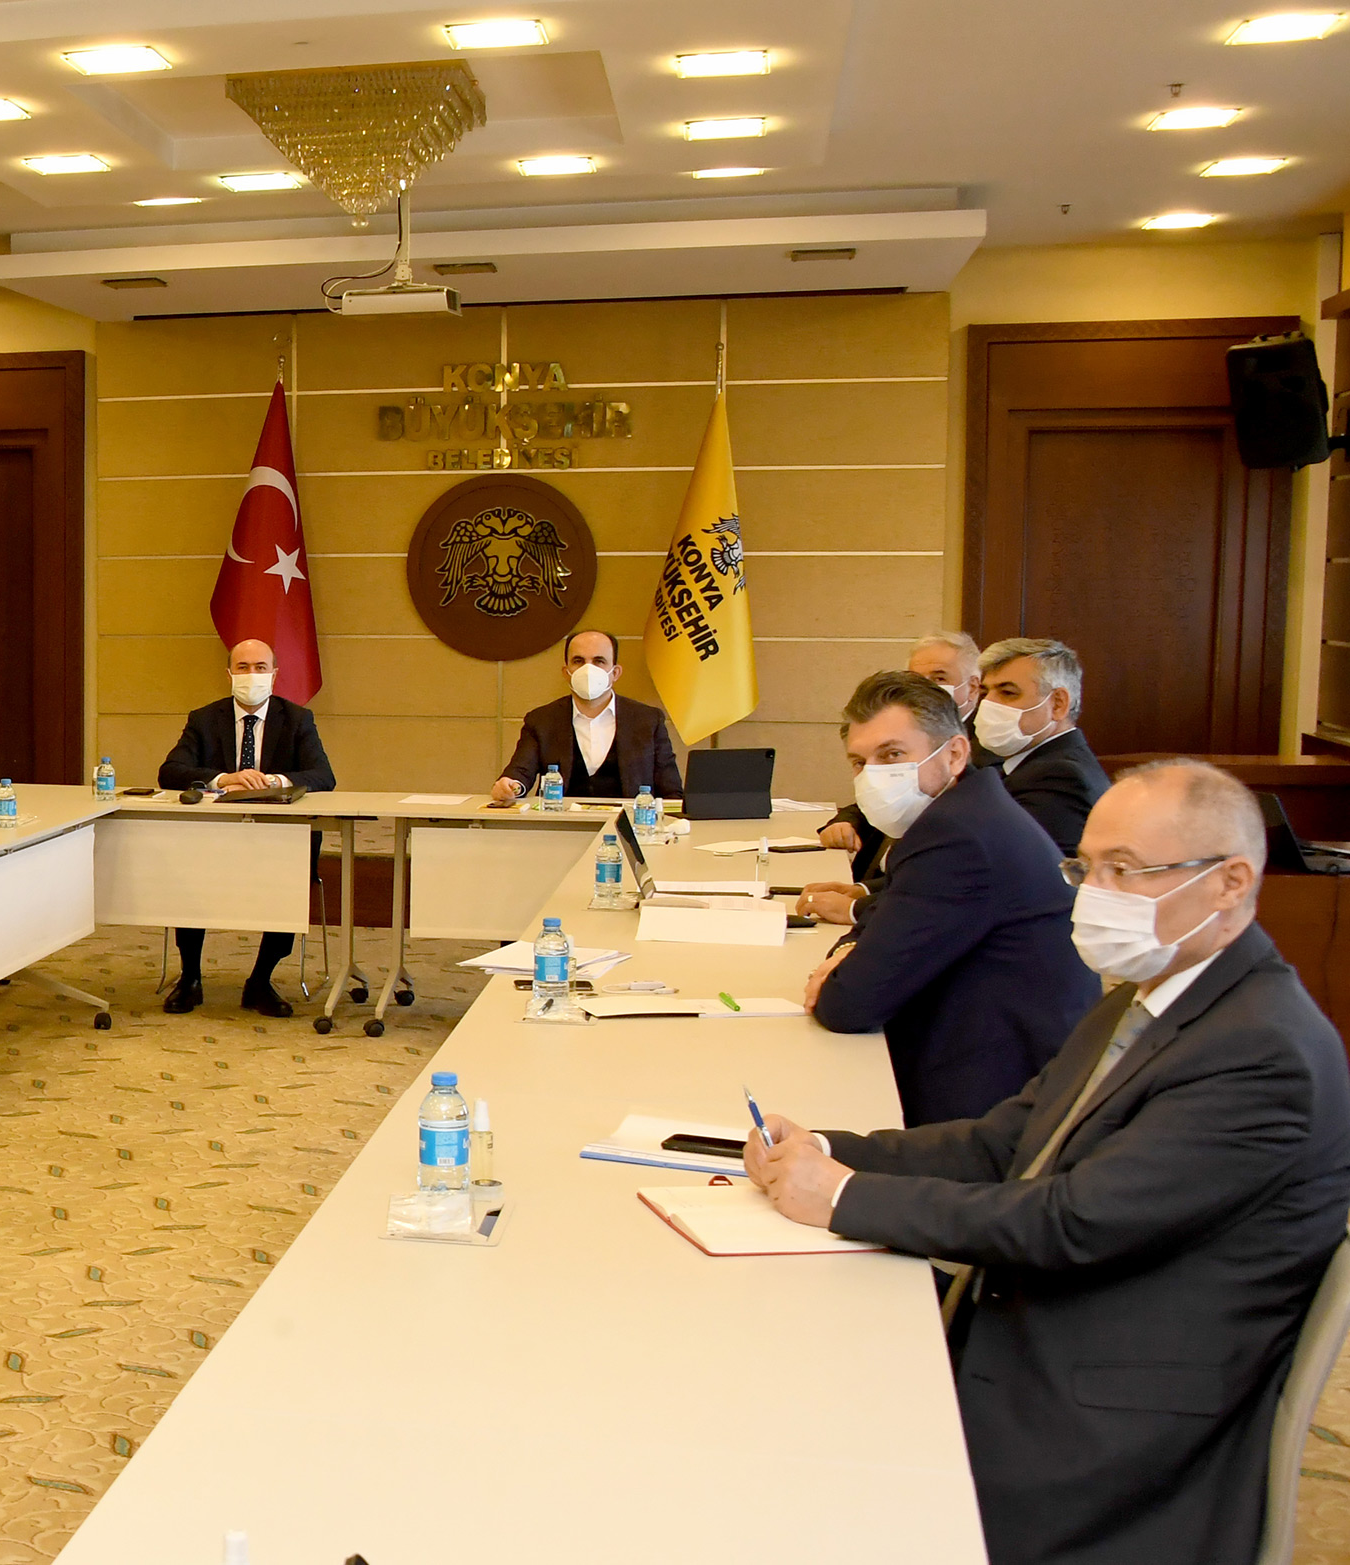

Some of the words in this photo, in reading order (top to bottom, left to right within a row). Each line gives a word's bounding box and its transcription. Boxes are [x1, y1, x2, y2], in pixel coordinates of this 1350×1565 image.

[442, 362, 568, 392] KONYA
[377, 394, 633, 445] BÜYÜKŞEHİR
[427, 443, 579, 470] BELEDİYESİ
[677, 533, 724, 612] KONYA
